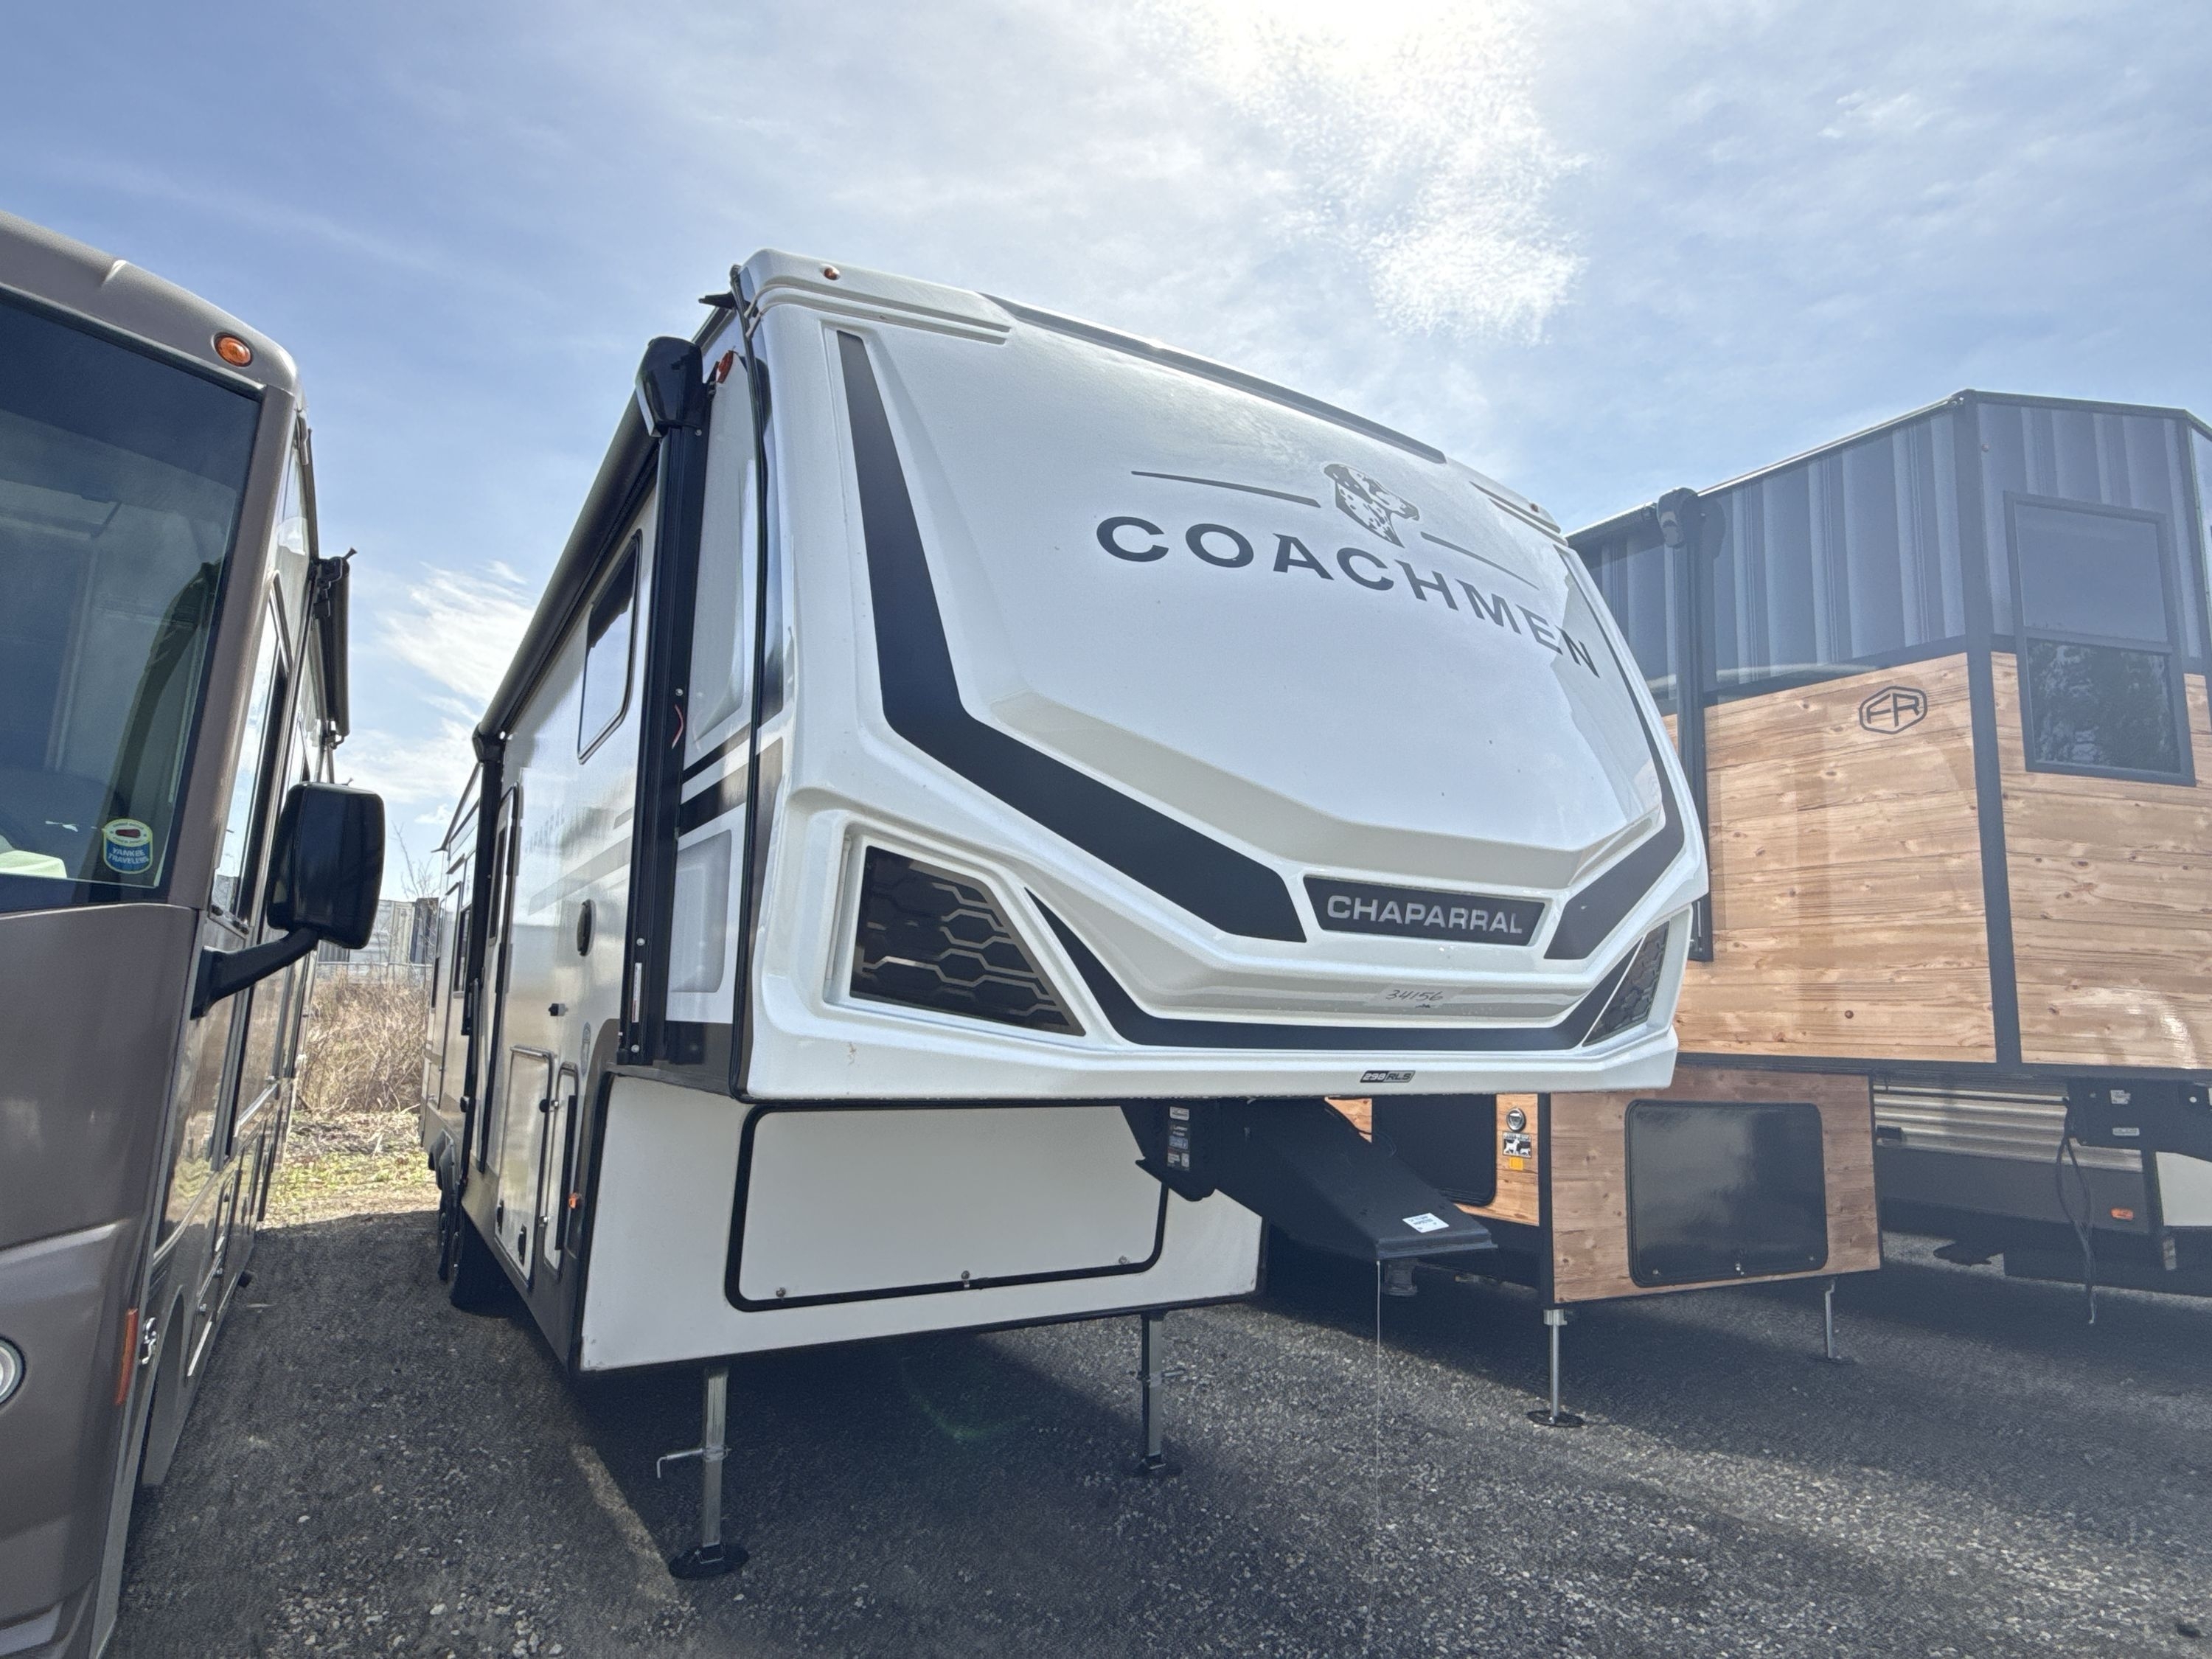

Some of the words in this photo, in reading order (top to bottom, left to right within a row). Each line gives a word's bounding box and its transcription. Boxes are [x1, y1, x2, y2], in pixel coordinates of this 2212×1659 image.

[1096, 515, 1600, 678] COACHMEN
[112, 846, 145, 857] YANKEE
[1327, 894, 1523, 934] CHAPARRAL
[1385, 989, 1444, 1001] 34156
